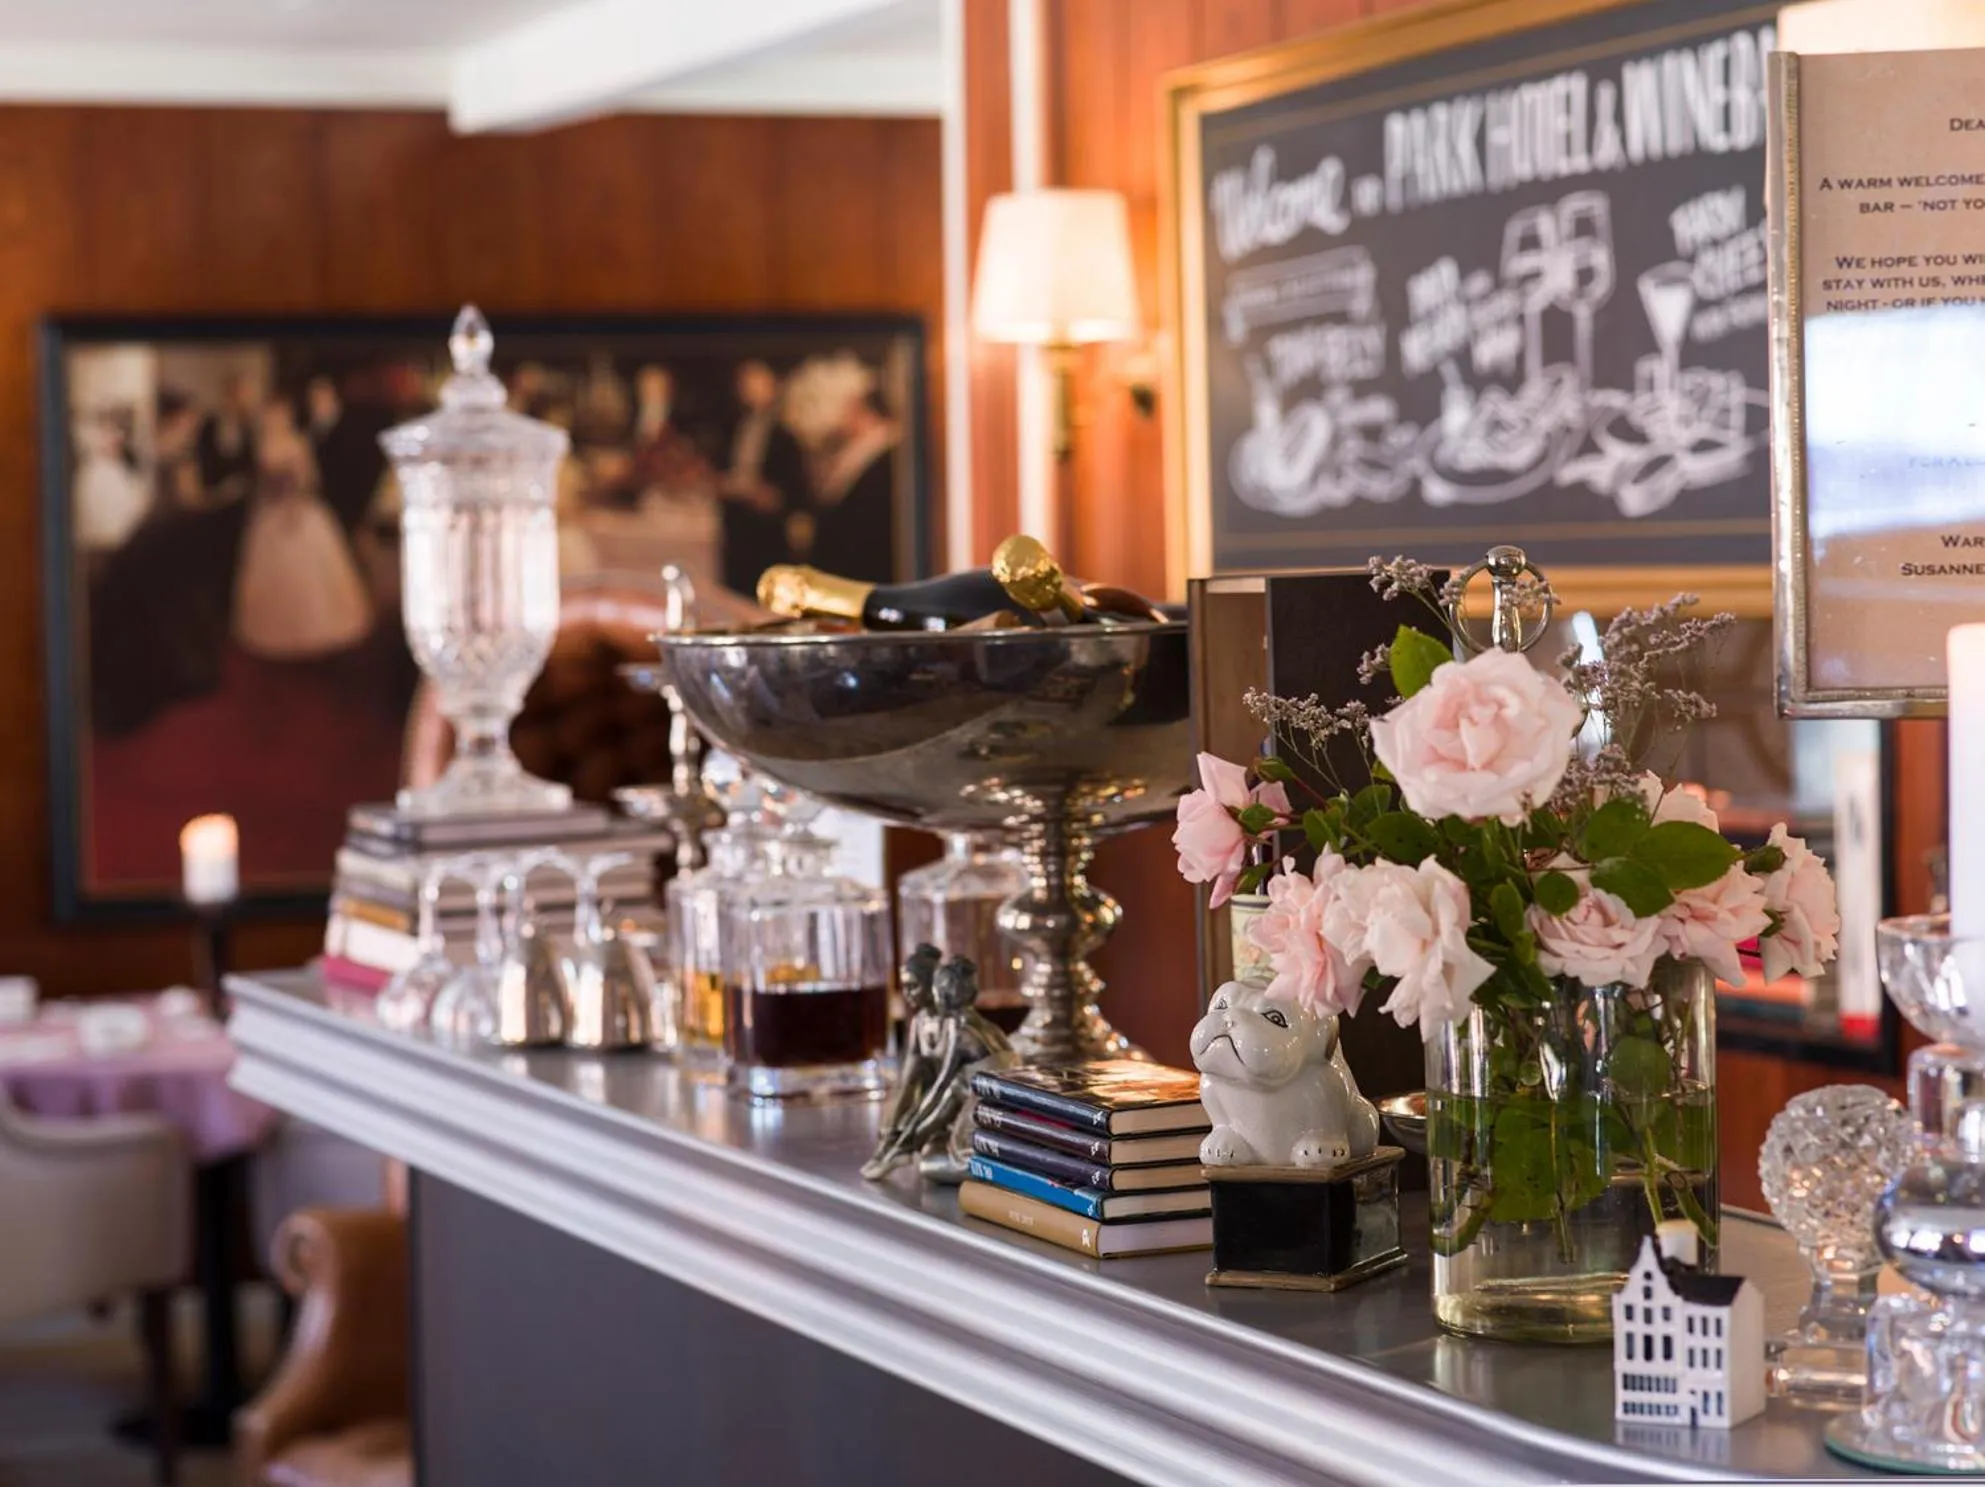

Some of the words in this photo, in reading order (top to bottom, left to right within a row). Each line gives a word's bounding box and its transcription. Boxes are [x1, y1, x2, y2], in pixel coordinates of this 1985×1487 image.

[1819, 177, 1833, 191] A
[1837, 177, 1892, 190] WARM
[1898, 174, 1985, 188] WELCOME
[1859, 202, 1895, 214] BAR
[1835, 256, 1866, 269] WE
[1870, 255, 1918, 268] HOPE
[1922, 254, 1957, 266] YOU
[1822, 278, 1864, 291] STAY
[1870, 277, 1914, 289] WITH
[1918, 276, 1946, 289] US,
[1826, 299, 1878, 312] NIGHT
[1892, 298, 1916, 309] OR
[1921, 297, 1935, 307] IF
[1940, 296, 1977, 307] YOU
[1900, 562, 1985, 576] SUSANNE
